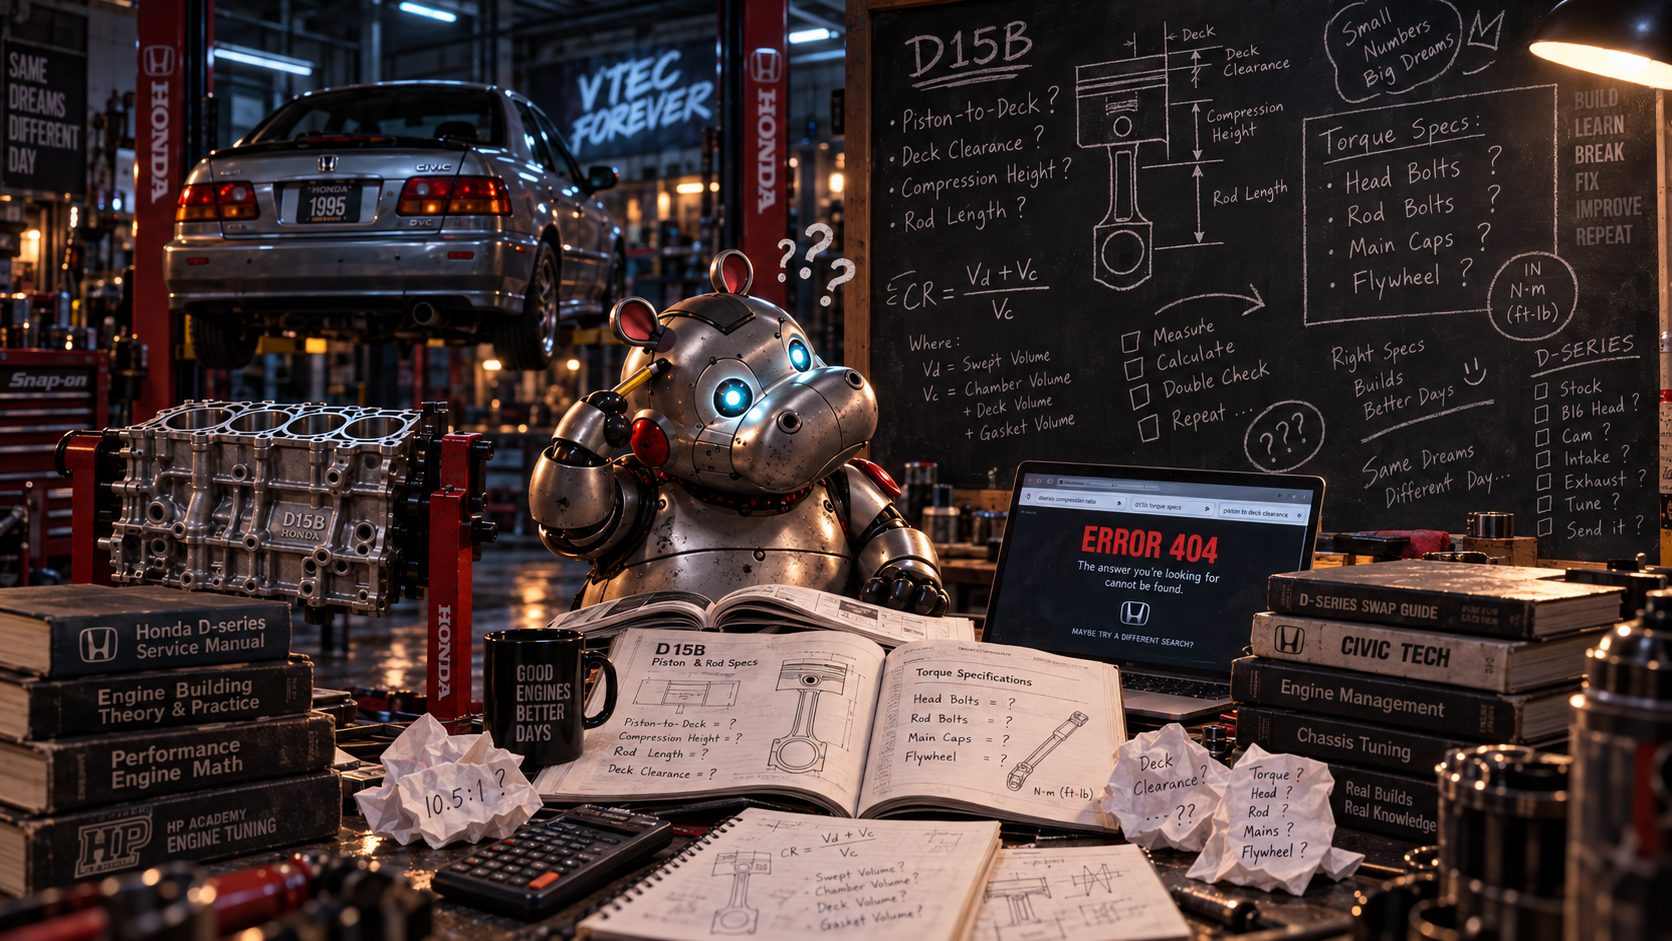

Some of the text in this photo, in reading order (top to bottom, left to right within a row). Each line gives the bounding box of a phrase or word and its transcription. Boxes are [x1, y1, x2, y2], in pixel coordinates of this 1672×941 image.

[1181, 25, 1217, 41] Deck
[1342, 7, 1393, 47] Small
[905, 20, 1034, 79] D15B
[1224, 46, 1260, 61] Deck
[1363, 20, 1431, 63] Numbers
[9, 52, 48, 84] SAME
[1223, 59, 1291, 77] Clearance
[1363, 33, 1454, 89] Big Dreams
[577, 48, 682, 112] VTEC
[8, 83, 67, 119] DREAMS
[1574, 88, 1619, 110] BUILD
[571, 81, 715, 157] FOREVER
[902, 92, 1040, 133] Piston-to-Deck
[1206, 102, 1284, 127] Compression
[8, 112, 80, 150] DIFFERENT
[1212, 122, 1258, 144] Height
[1574, 115, 1625, 138] LEARN
[150, 81, 169, 203] HONDA
[757, 88, 777, 215] HONDA
[902, 137, 1024, 168] Deck Clearance
[1319, 126, 1397, 156] Torque
[8, 146, 37, 175] DAY
[1574, 143, 1625, 165] BREAK
[415, 163, 452, 172] CIVIC
[1345, 157, 1461, 195] Head Bolts
[901, 163, 1057, 200] Compression Height
[1212, 180, 1289, 207] Rod Length
[1575, 172, 1600, 192] FIX
[309, 197, 346, 217] 1995
[1576, 197, 1643, 219] IMPROVE
[1348, 231, 1454, 259] Main Caps
[1576, 224, 1634, 246] REPEAT
[1353, 263, 1440, 300] Flywheel
[1524, 262, 1542, 276] IN
[1154, 318, 1215, 346] Measure
[963, 350, 1050, 374] Swept Volume
[1157, 340, 1236, 371] Calculate
[1331, 339, 1426, 375] Right Specs
[1535, 334, 1635, 368] D-SERIES
[9, 372, 88, 391] Snap-on
[964, 371, 1072, 397] Chamber Volume
[1163, 359, 1271, 399] Double Check
[1354, 373, 1404, 398] Builds
[1560, 379, 1602, 397] Stock
[1364, 384, 1455, 421] Better Days
[1590, 399, 1625, 417] Head
[1172, 402, 1226, 432] Repeat
[1562, 428, 1593, 444] Cam
[1564, 448, 1611, 465] Intake
[1564, 473, 1627, 491] Exhaust
[1564, 497, 1602, 512] Tune
[282, 511, 325, 532] D15B
[1567, 518, 1626, 540] Send it
[281, 529, 320, 541] HONDA
[1081, 525, 1218, 564] ERROR 404
[1078, 560, 1220, 584] The answer you're looking for
[1105, 579, 1183, 594] cannot be found.
[1300, 593, 1357, 614] D-SERIES
[1361, 599, 1397, 616] SWAP
[1400, 602, 1438, 620] GUIDE
[136, 616, 266, 641] Honda D-series
[1071, 628, 1096, 637] MAYBE
[1098, 630, 1112, 639] TRY
[1121, 633, 1159, 645] DIFFERENT
[1161, 638, 1193, 648] SEARCH?
[136, 633, 265, 660] Service Manual
[438, 604, 451, 701] HONDA
[655, 643, 706, 656] D15B
[1341, 634, 1451, 669] CIVIC TECH
[516, 664, 554, 682] GOOD
[651, 658, 686, 667] Piston
[694, 659, 702, 667] &
[728, 659, 758, 668] Specs
[916, 668, 1032, 687] Torque Specifications
[97, 678, 252, 708] Engine Building
[516, 683, 571, 702] ENGINES
[914, 694, 979, 706] Head Bolts
[1281, 678, 1334, 702] Engine
[1339, 686, 1446, 719] Management
[98, 697, 260, 725] Theory & Practice
[516, 703, 565, 722] BETTER
[516, 725, 551, 742] DAYS
[619, 731, 720, 745] Compression Height
[908, 733, 972, 745] Main Caps
[1297, 727, 1355, 751] Chassis
[1358, 734, 1412, 763] Tuning
[111, 740, 241, 769] Performance
[905, 751, 957, 766] Flywheel
[111, 768, 181, 790] Engine
[192, 757, 243, 778] Math
[608, 764, 691, 779] Deck Clearance
[1249, 765, 1290, 785] Torque
[424, 778, 485, 819] 10.5:1
[1345, 780, 1414, 808] Real Builds
[167, 808, 247, 833] HP ACADEMY
[1249, 805, 1269, 818] Rod
[1344, 800, 1437, 833] Real Knowledge
[167, 817, 277, 853] ENGINE TUNING
[1244, 825, 1279, 838] Mains
[1242, 843, 1293, 865] Flywheel
[816, 872, 850, 882] Swept
[816, 883, 865, 897] Chamber
